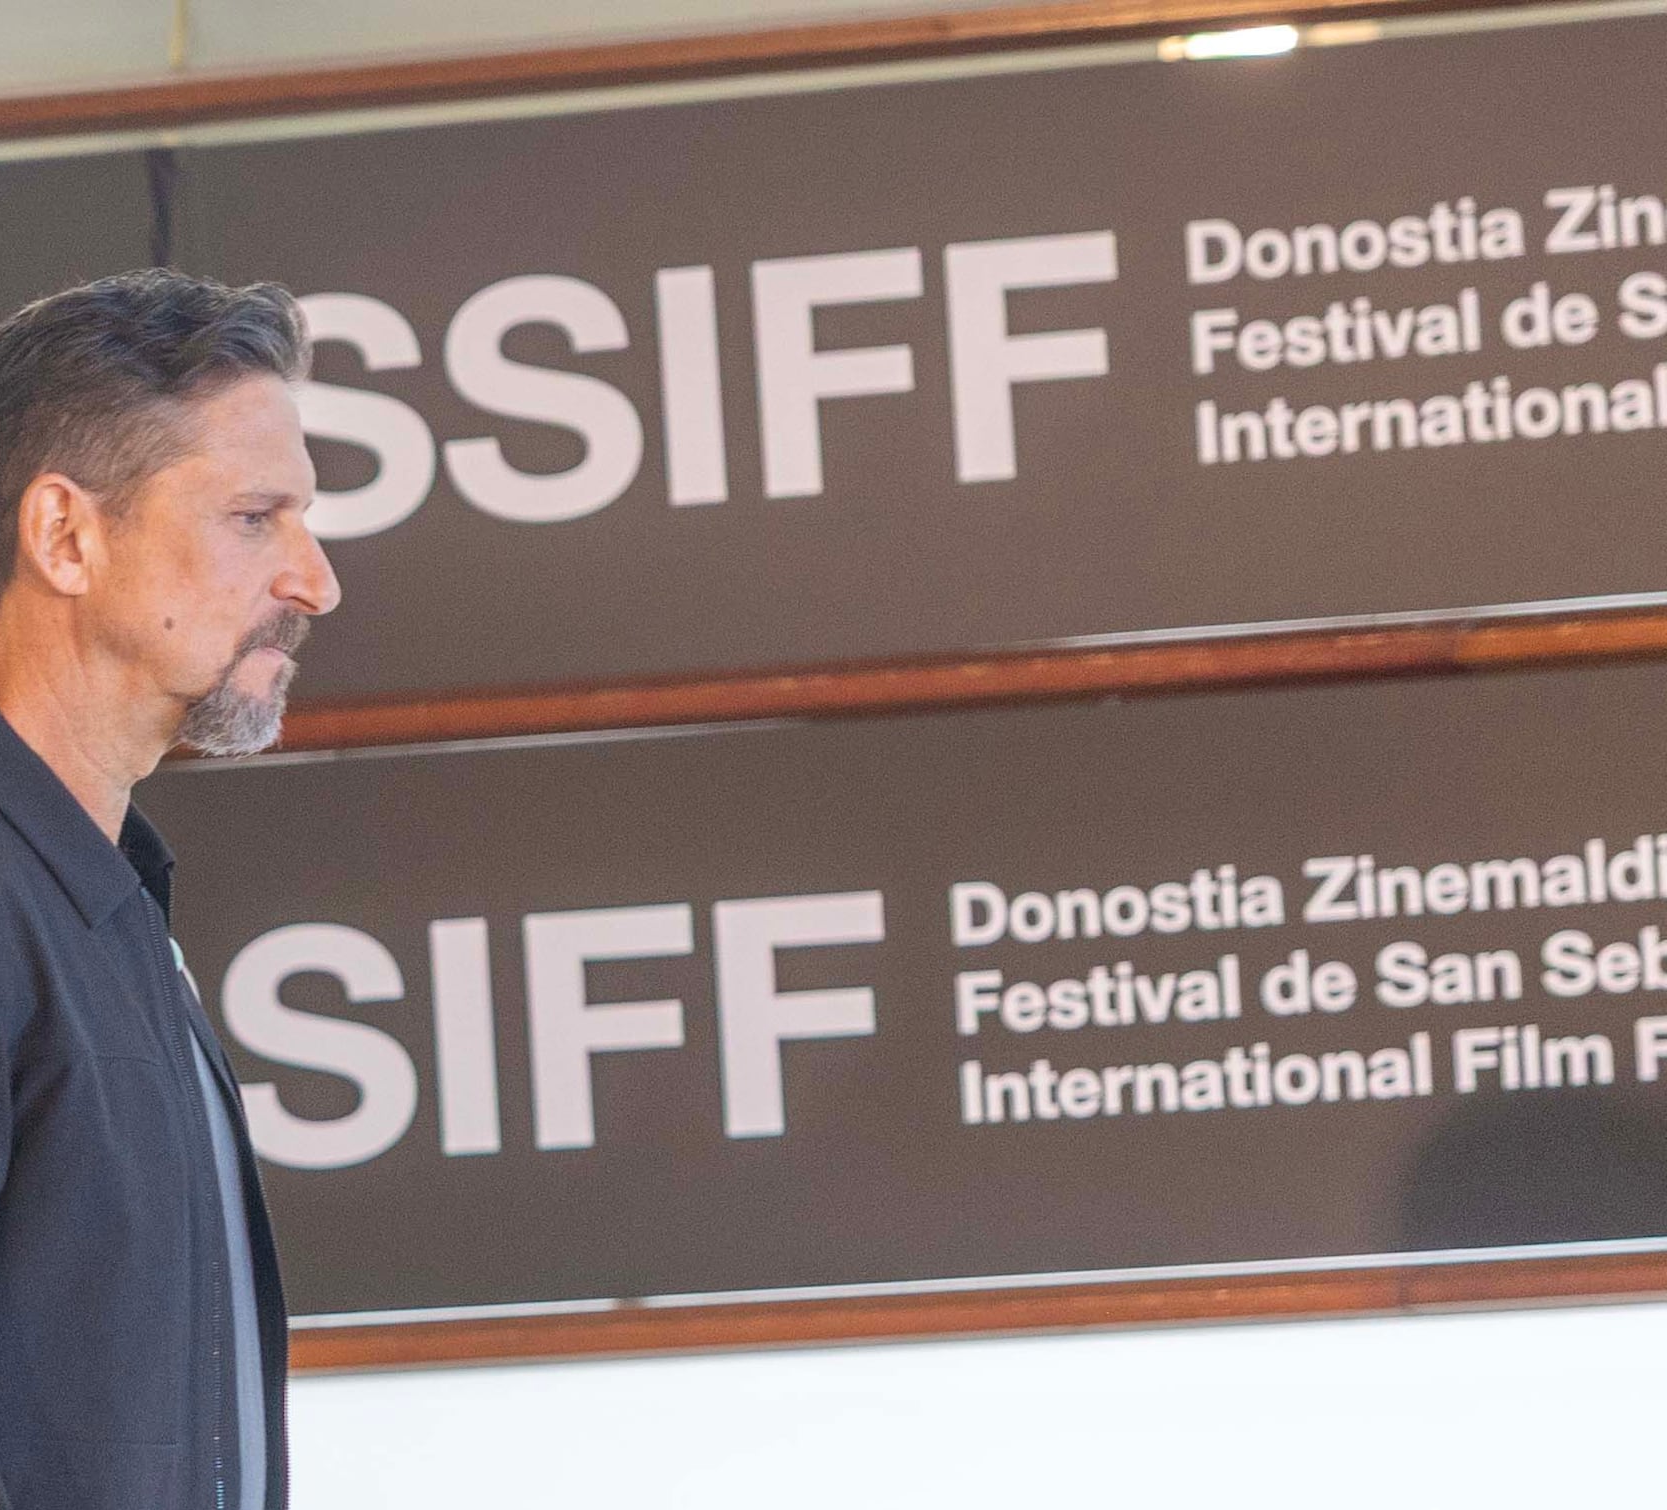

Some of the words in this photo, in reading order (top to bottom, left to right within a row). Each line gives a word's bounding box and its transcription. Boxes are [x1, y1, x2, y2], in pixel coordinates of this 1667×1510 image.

[1185, 196, 1525, 284] Donostia
[1544, 184, 1667, 254] Zin
[1190, 288, 1482, 375] Festival
[1502, 281, 1598, 348] de
[296, 230, 1119, 540] SSIFF
[1195, 362, 1667, 464] International
[951, 863, 1285, 947] Donostia
[212, 890, 886, 1170] SIFF
[956, 954, 1242, 1035] Festival
[1260, 949, 1357, 1016] de
[1376, 940, 1523, 1008] San
[1542, 925, 1667, 997] Seb
[960, 1031, 1433, 1124] International
[1452, 1024, 1615, 1093] Film
